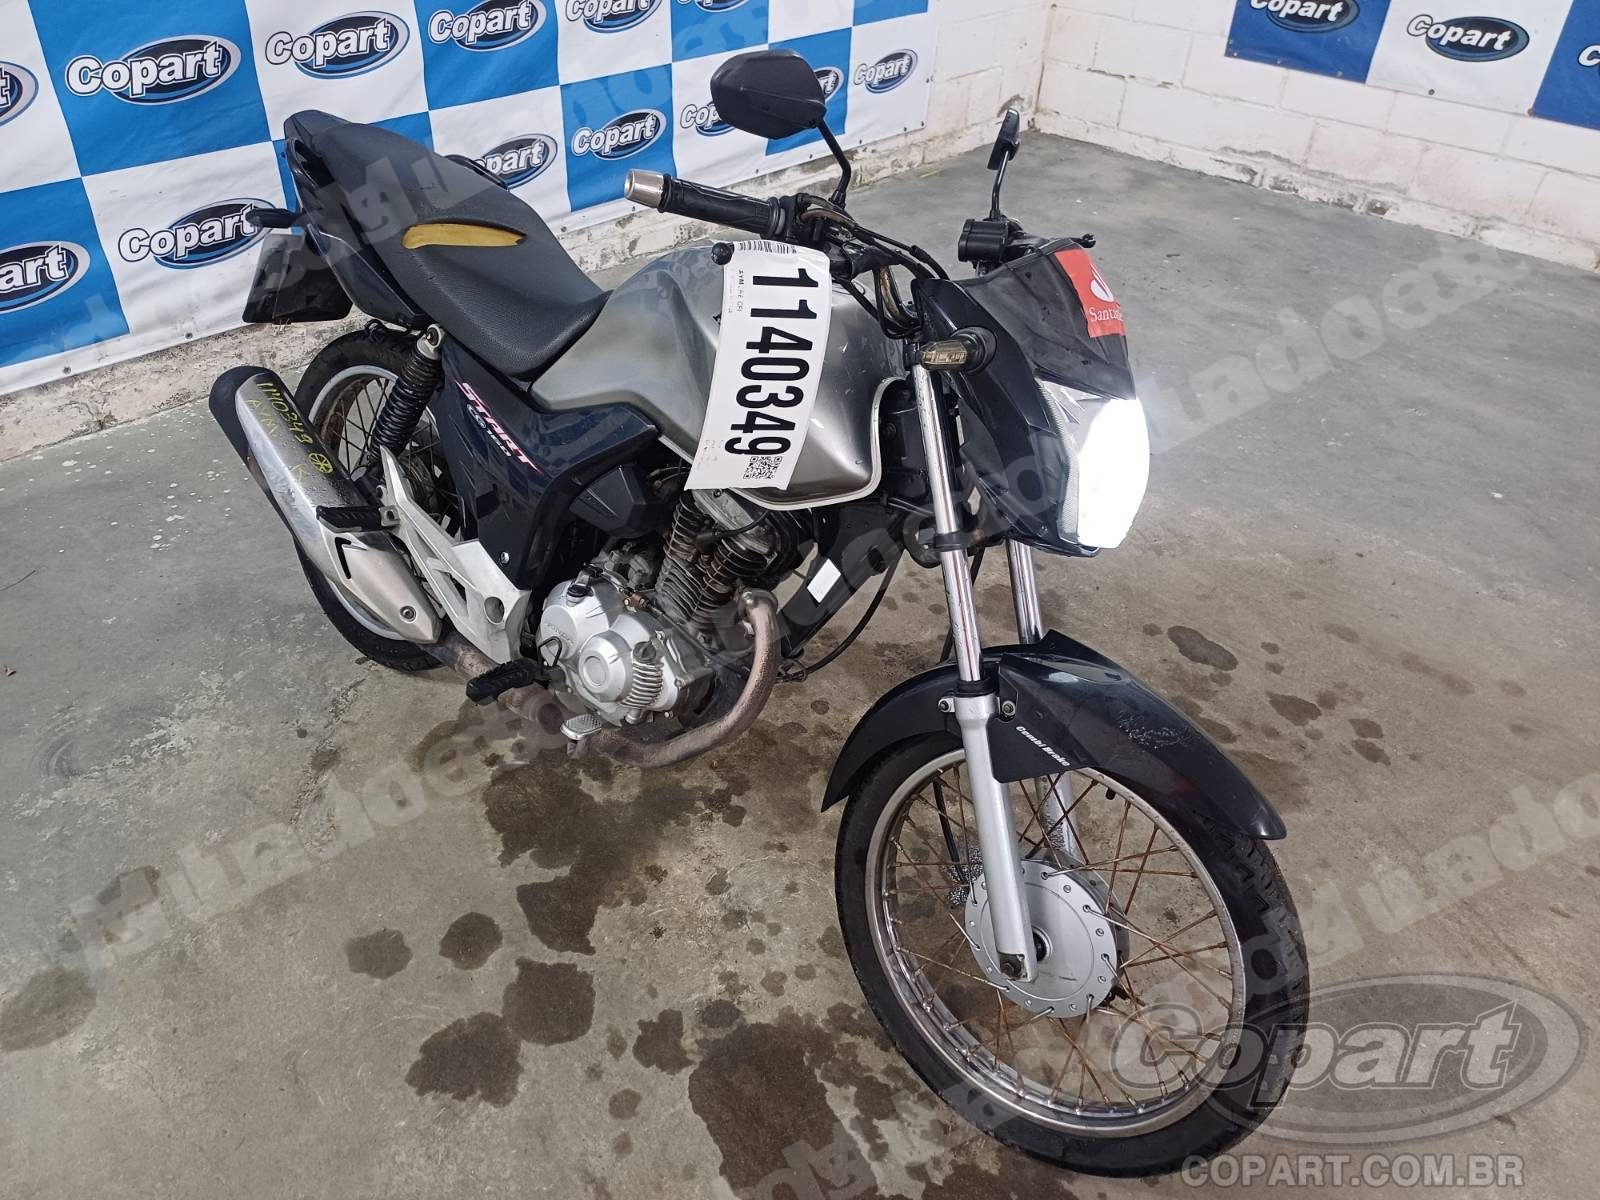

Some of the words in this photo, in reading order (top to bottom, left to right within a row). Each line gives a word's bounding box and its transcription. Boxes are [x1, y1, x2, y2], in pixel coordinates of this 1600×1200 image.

[264, 18, 391, 69] Copart
[428, 0, 533, 45] Copart
[1407, 14, 1515, 51] Copart
[65, 40, 223, 97] Copart
[854, 54, 912, 87] Copart
[571, 113, 658, 157] Copart
[680, 103, 723, 129] Cop
[118, 203, 257, 263] Copart
[0, 242, 70, 292] art
[724, 267, 819, 456] 1140349
[256, 382, 314, 445] 1140349
[454, 379, 545, 476] START
[1016, 726, 1047, 748] Combi
[1041, 746, 1071, 767] Brake
